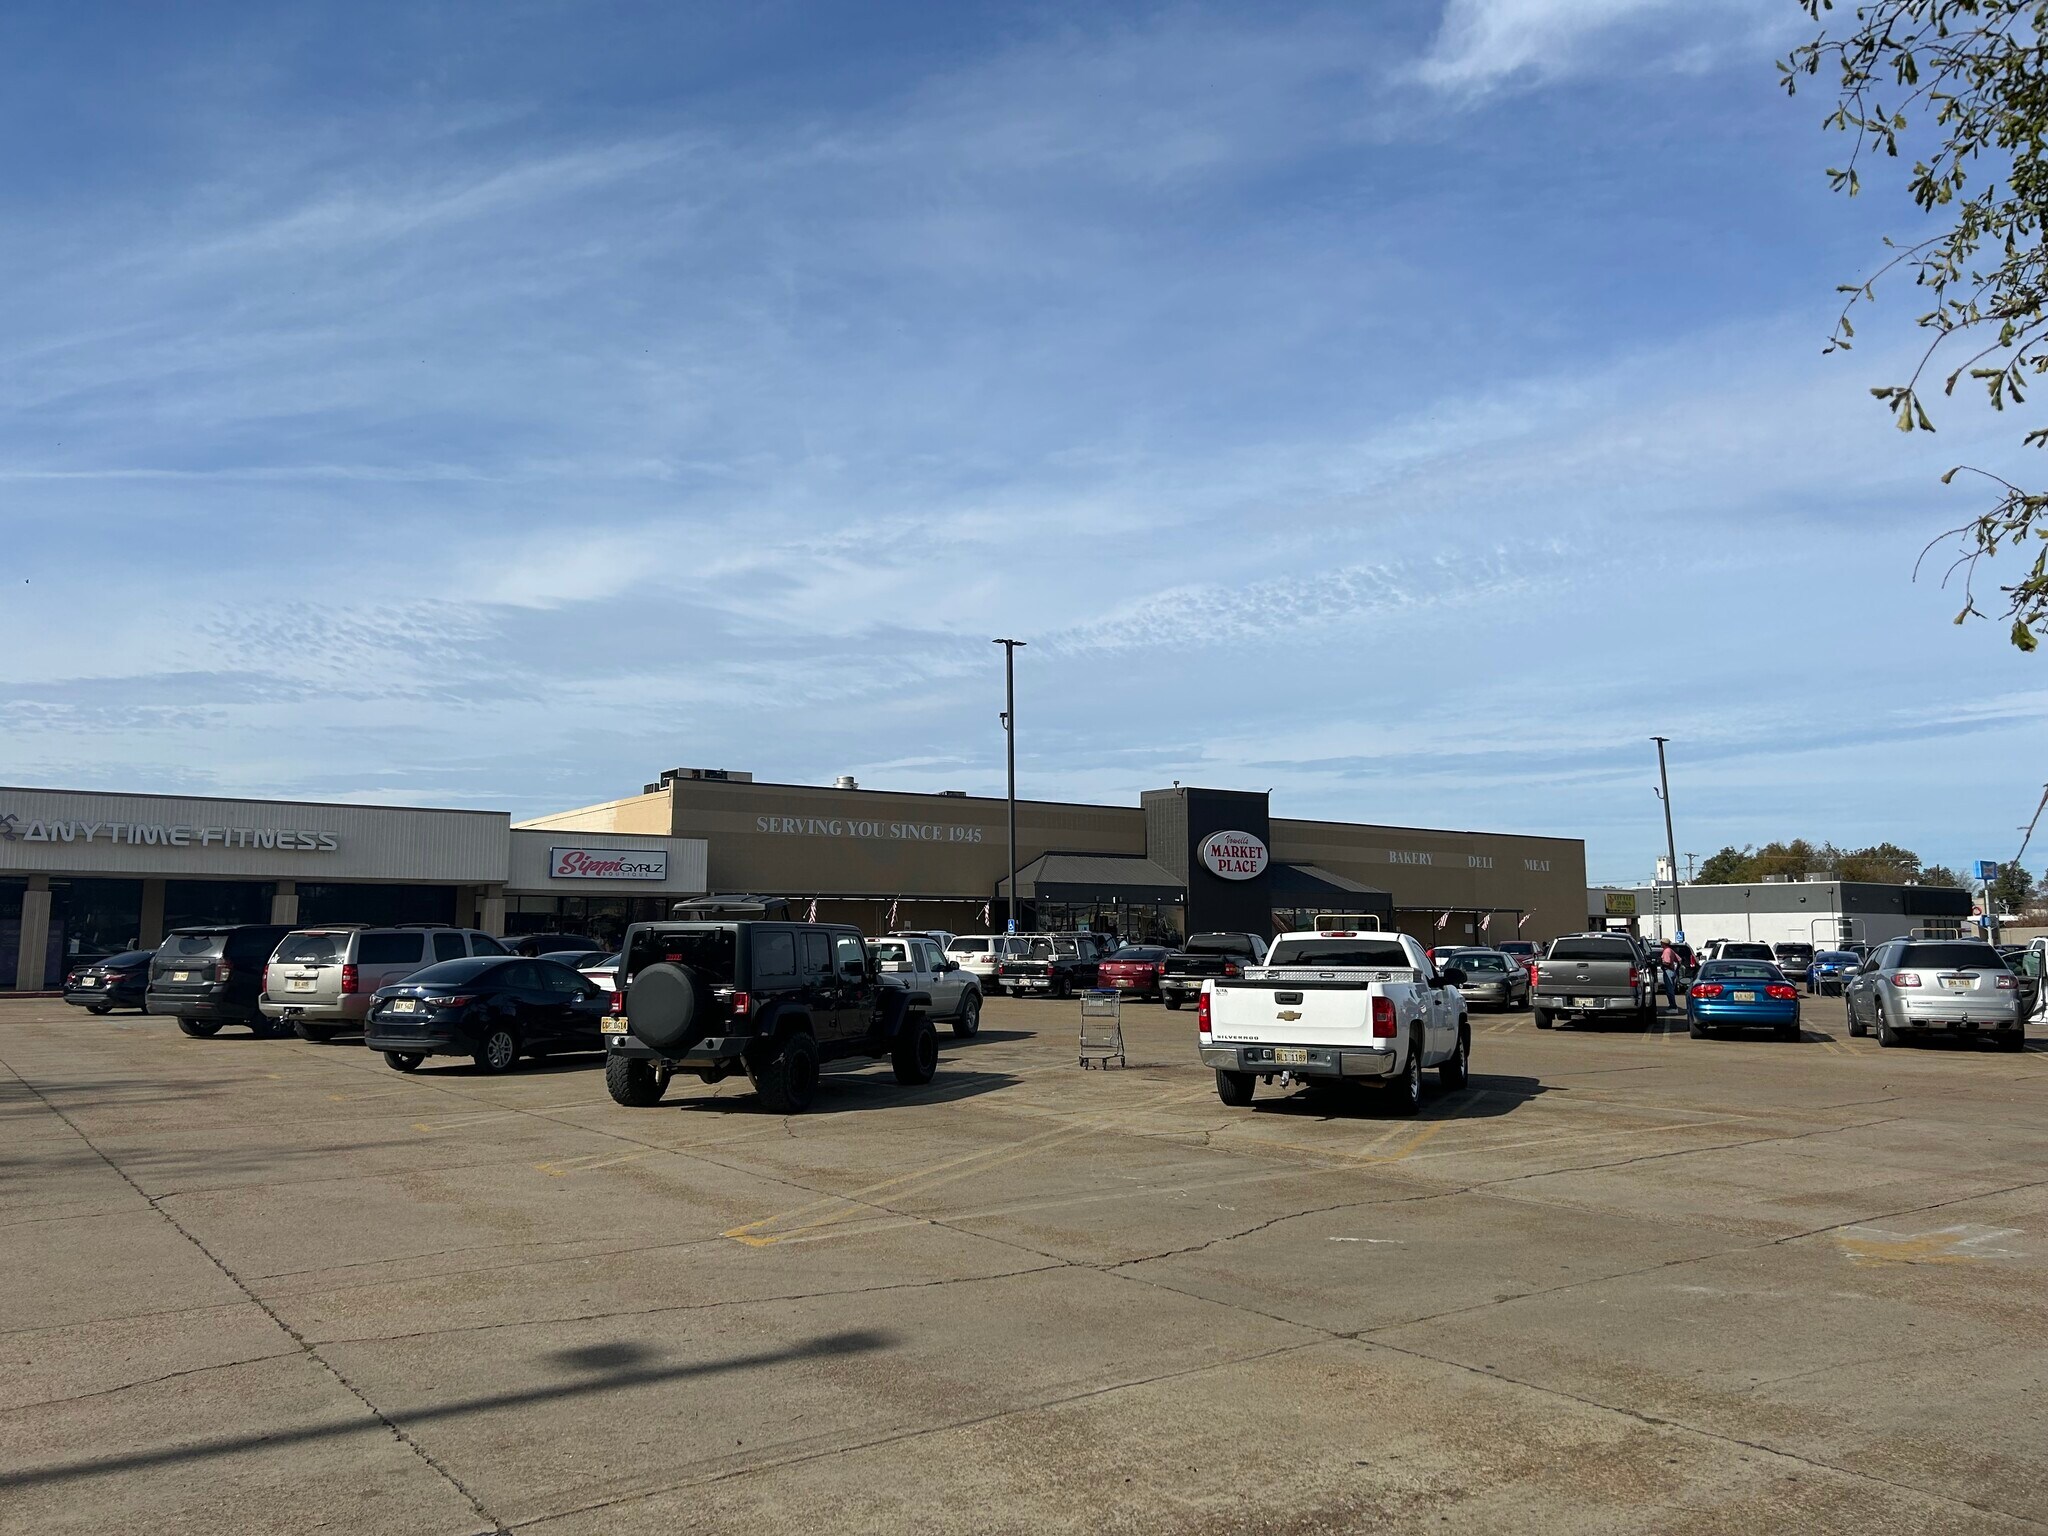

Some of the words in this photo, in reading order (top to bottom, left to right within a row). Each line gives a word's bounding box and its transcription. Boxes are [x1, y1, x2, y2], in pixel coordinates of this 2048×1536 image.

[23, 819, 191, 846] ANYTIME
[202, 826, 338, 851] FITNESS
[756, 816, 842, 836] SERVING
[847, 821, 885, 838] YOU
[890, 823, 943, 840] SINCE
[949, 826, 982, 843] 1945
[1211, 844, 1263, 859] MARKET
[1389, 851, 1433, 865] BAKERY
[1218, 860, 1257, 873] PLACE
[1468, 856, 1493, 869] DELI
[1524, 859, 1551, 872] MEAT
